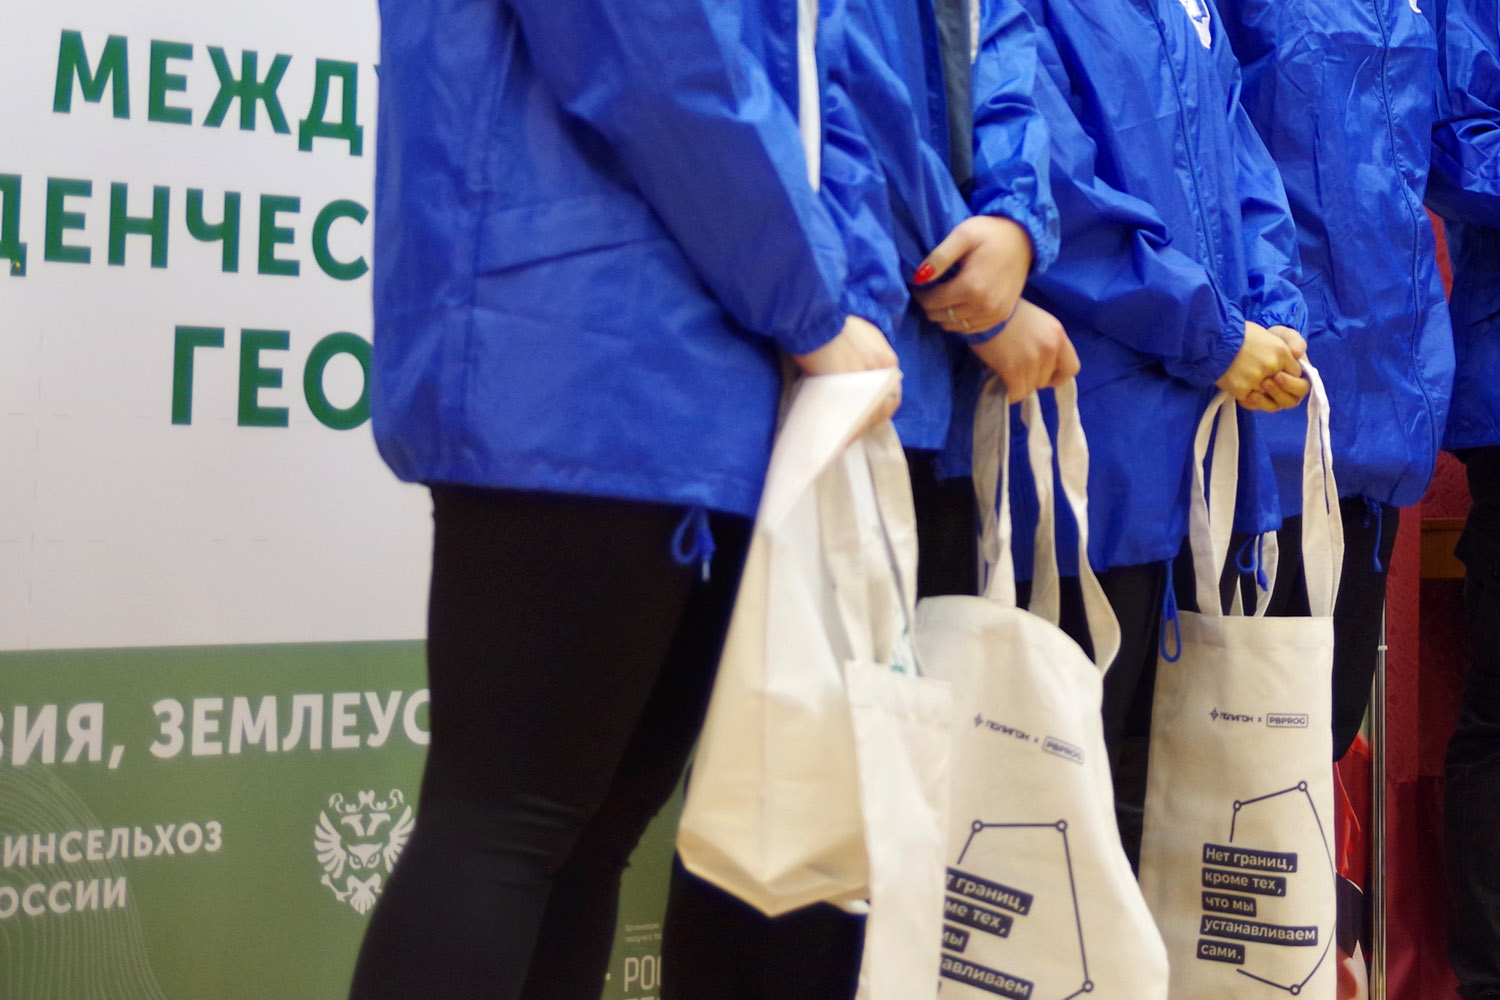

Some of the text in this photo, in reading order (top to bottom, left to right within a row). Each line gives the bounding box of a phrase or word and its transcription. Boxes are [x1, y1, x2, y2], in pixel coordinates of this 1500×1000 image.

[52, 28, 381, 157] МЕЖД
[171, 324, 374, 430] ГЕО
[0, 689, 431, 769] ИЯ, ЗЕМЛЕУС
[3, 820, 223, 867] ИНСЕЛЬХОЗ
[1206, 847, 1294, 871] Нет границ,
[0, 876, 127, 918] ОССИИ
[956, 878, 1026, 913] границ,
[1205, 871, 1282, 894] кроме тех,
[973, 909, 1006, 934] тех,
[1205, 896, 1254, 912] что мы
[1204, 918, 1316, 940] устанавливаем
[1200, 944, 1242, 960] сами.
[624, 955, 661, 993] РО
